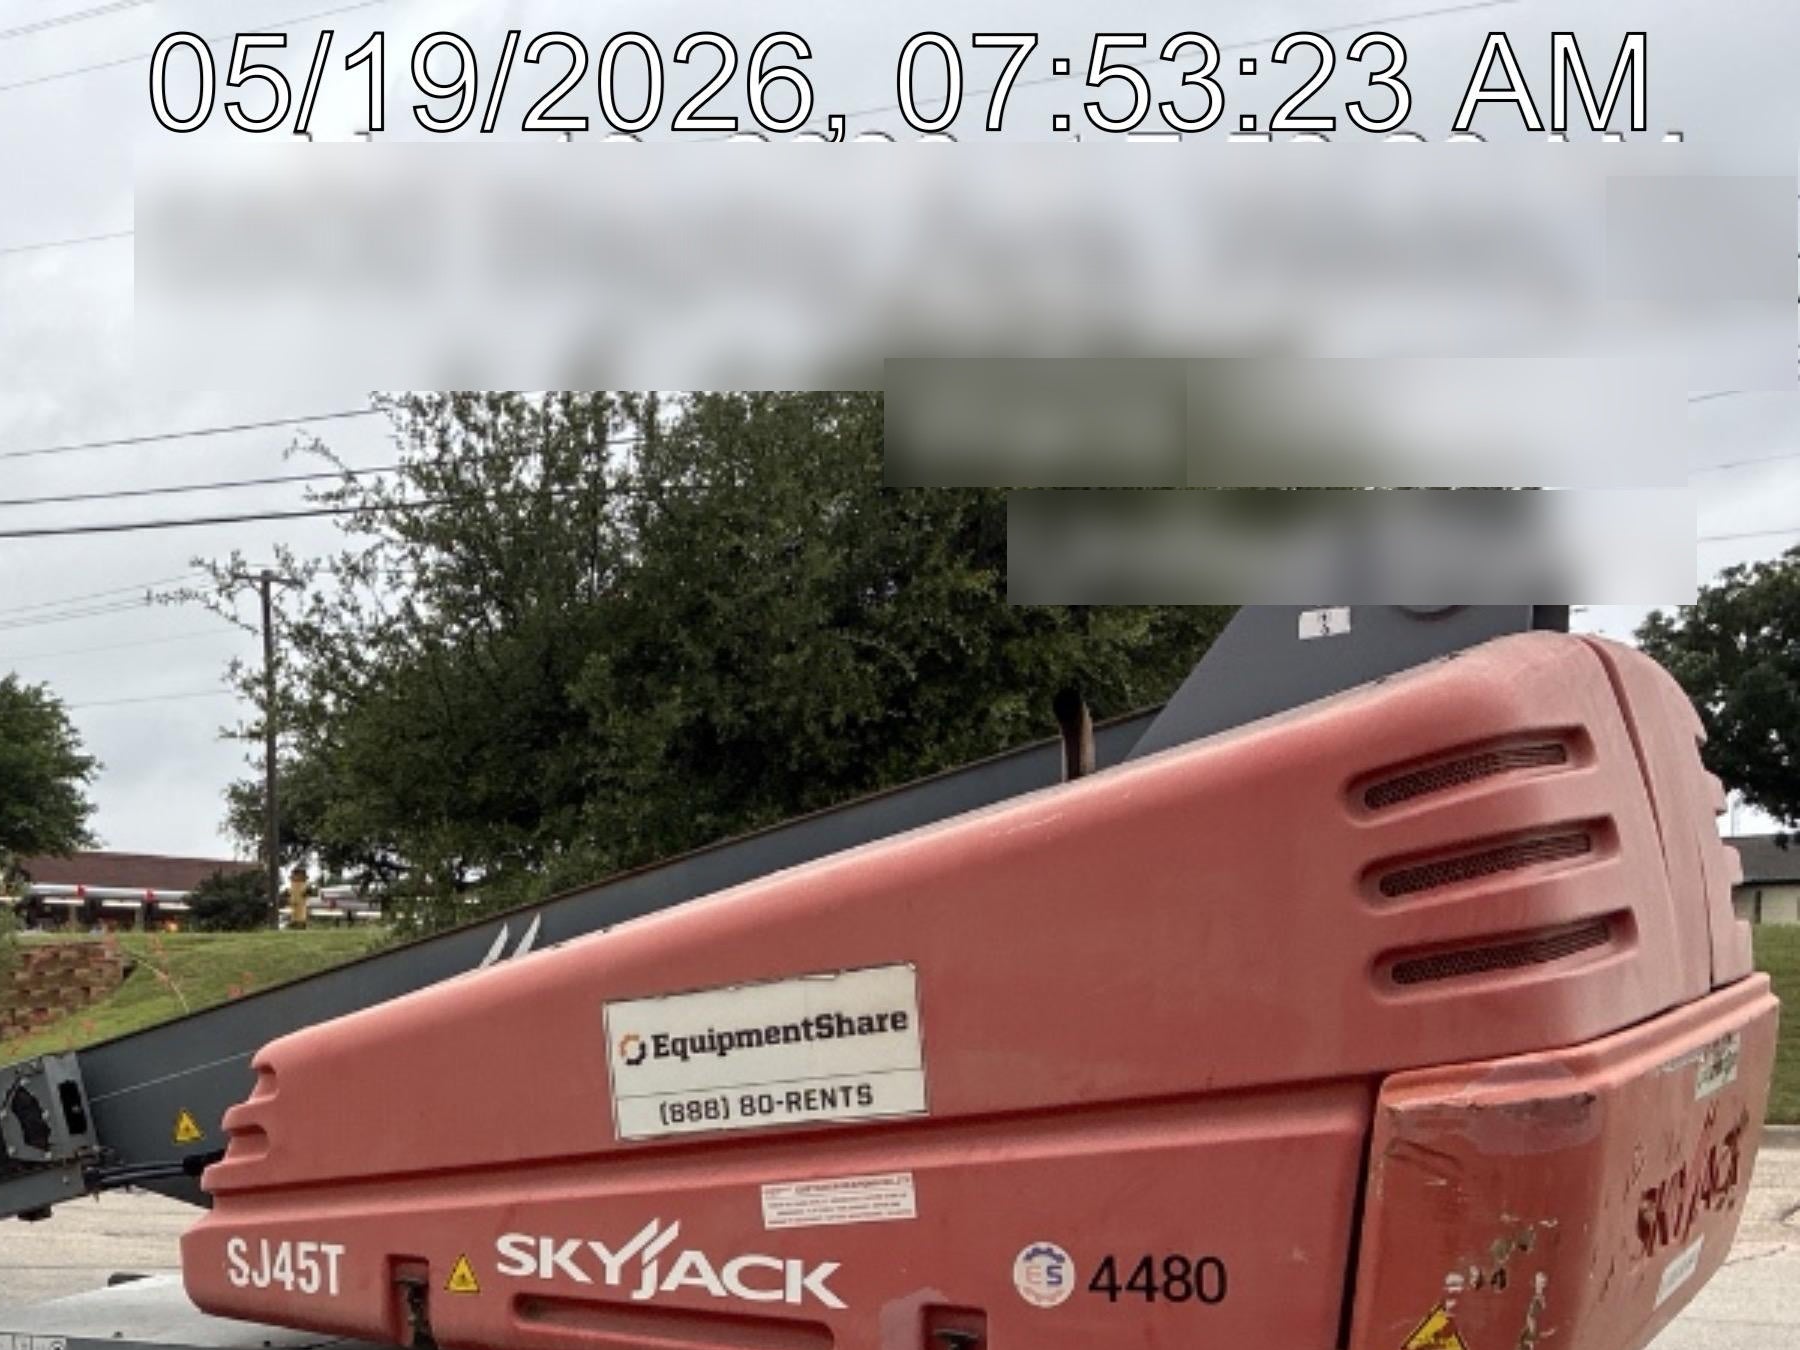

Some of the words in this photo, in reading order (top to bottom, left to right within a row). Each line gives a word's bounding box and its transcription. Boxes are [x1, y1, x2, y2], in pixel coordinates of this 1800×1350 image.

[650, 1009, 908, 1063] EquipmentShare
[659, 1096, 731, 1126] (888)
[739, 1083, 874, 1117] 80-RENTS
[226, 1237, 346, 1297] SJ45T
[495, 1218, 849, 1310] SKYJACK
[1088, 1254, 1228, 1305] 4480
